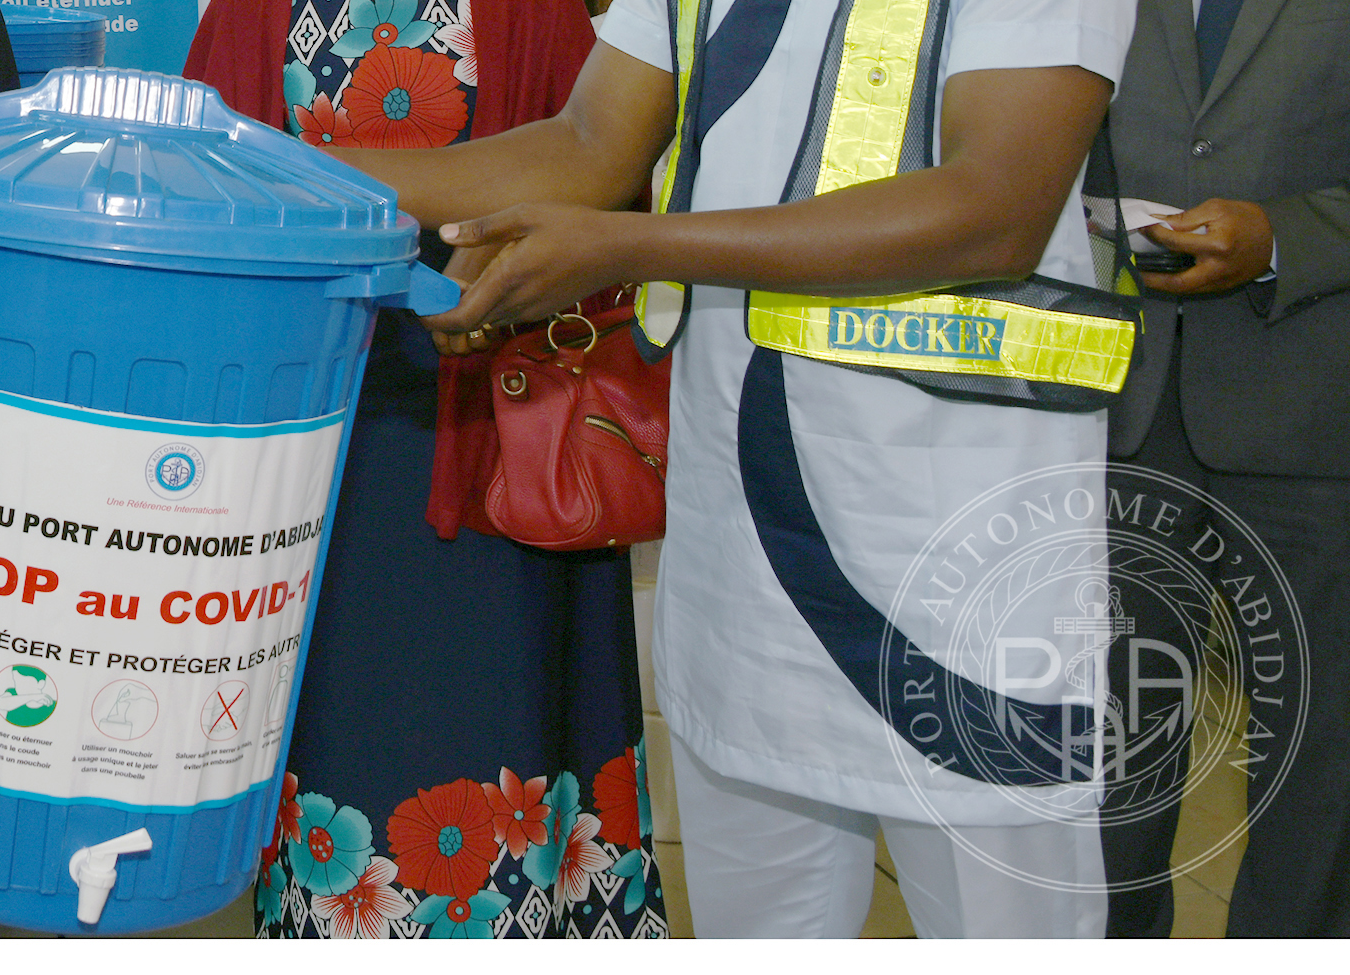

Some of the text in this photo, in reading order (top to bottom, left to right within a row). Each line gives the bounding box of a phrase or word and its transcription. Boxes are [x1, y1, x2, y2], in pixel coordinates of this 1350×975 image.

[833, 310, 997, 356] DOCKER
[106, 497, 229, 515] Une Référence Internationale
[23, 512, 99, 547] PORT
[105, 529, 254, 558] AUTONOME
[260, 514, 325, 555] D'ABIDJA
[75, 590, 140, 621] au
[159, 569, 310, 626] COVID-1
[68, 648, 101, 668] ET
[106, 651, 231, 676] PROTÉGER
[237, 648, 266, 671] LES
[268, 633, 301, 662] AUTR
[22, 736, 53, 746] éternuer
[17, 747, 40, 756] coude
[118, 748, 153, 758] mouchoir
[219, 746, 237, 754] serrer
[16, 758, 52, 769] mouchoir
[100, 756, 125, 766] unique
[114, 770, 145, 780] poubelle
